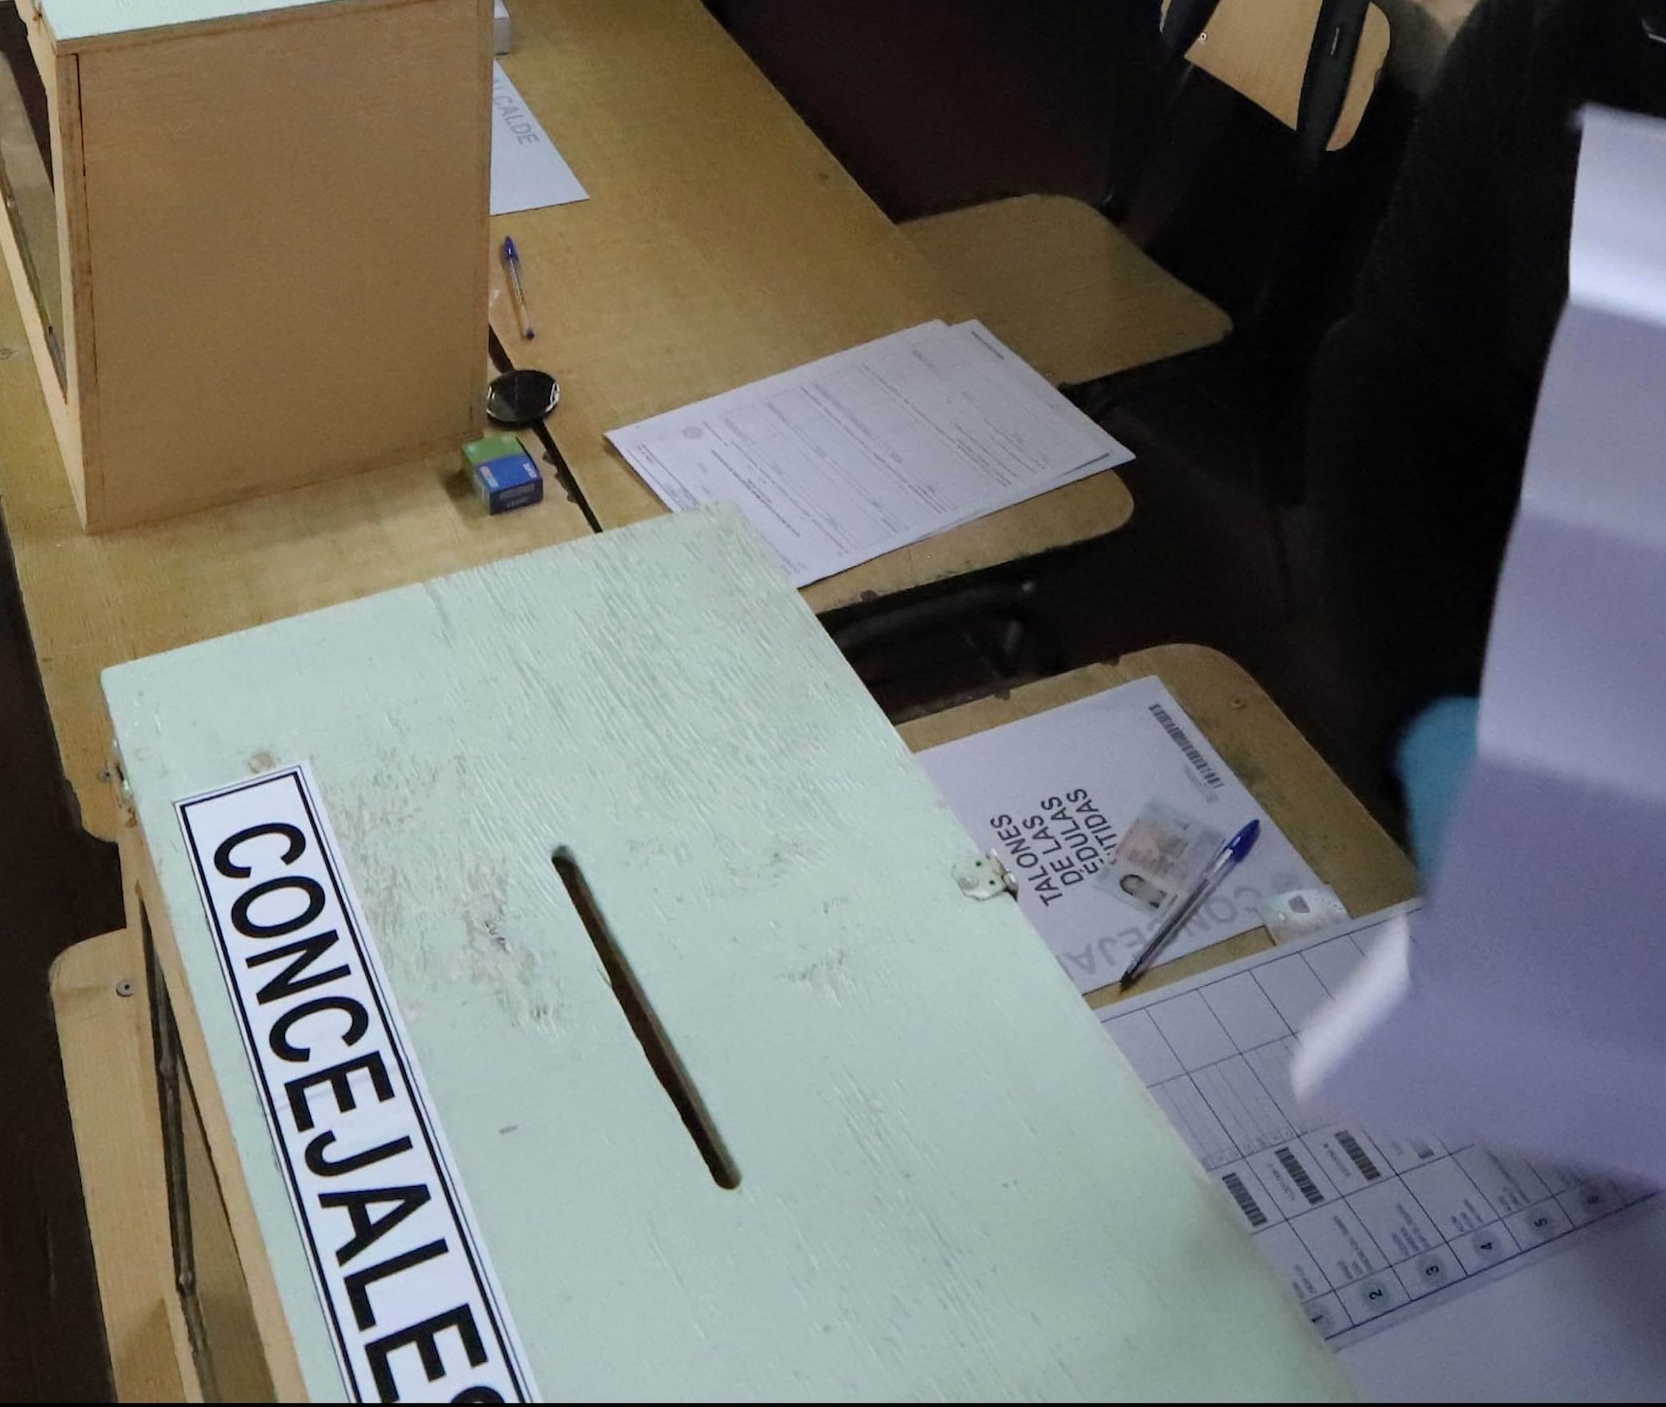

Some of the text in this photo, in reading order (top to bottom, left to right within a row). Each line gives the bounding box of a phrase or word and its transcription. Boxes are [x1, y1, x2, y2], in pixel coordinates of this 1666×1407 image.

[1022, 815, 1084, 886] DE LAS
[990, 814, 1063, 907] TALONES
[213, 822, 506, 1403] CONCEJALE
[1534, 1216, 1549, 1228] 5
[1480, 1240, 1493, 1252] 4
[1425, 1263, 1440, 1277] 3
[1368, 1288, 1383, 1301] 2
